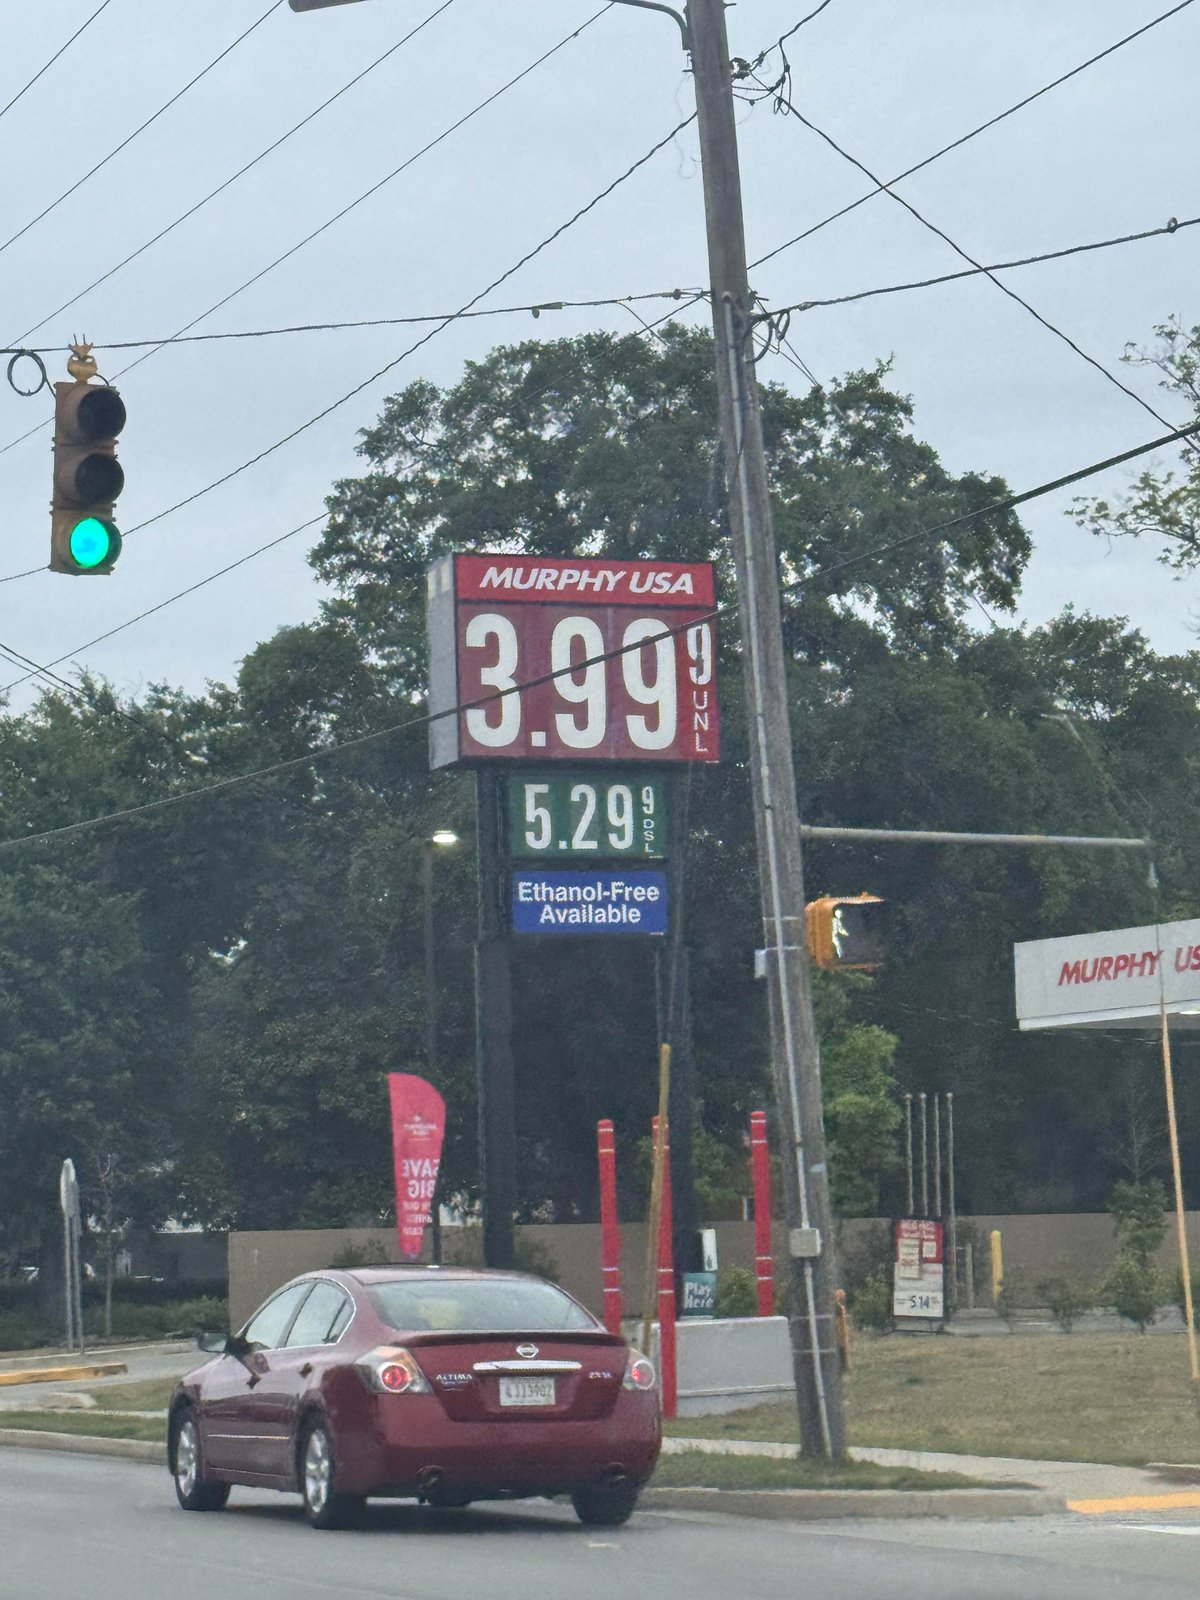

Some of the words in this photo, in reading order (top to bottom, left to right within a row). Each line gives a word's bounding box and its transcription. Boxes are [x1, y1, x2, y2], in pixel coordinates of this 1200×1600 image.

[479, 566, 626, 592] MURPHY
[629, 571, 694, 594] USA
[465, 613, 678, 750] 3.99
[524, 783, 634, 850] 5.29
[641, 785, 655, 814] 9
[518, 881, 660, 902] Ethanol-Free
[540, 903, 641, 924] Available
[1058, 950, 1165, 986] MURPHY
